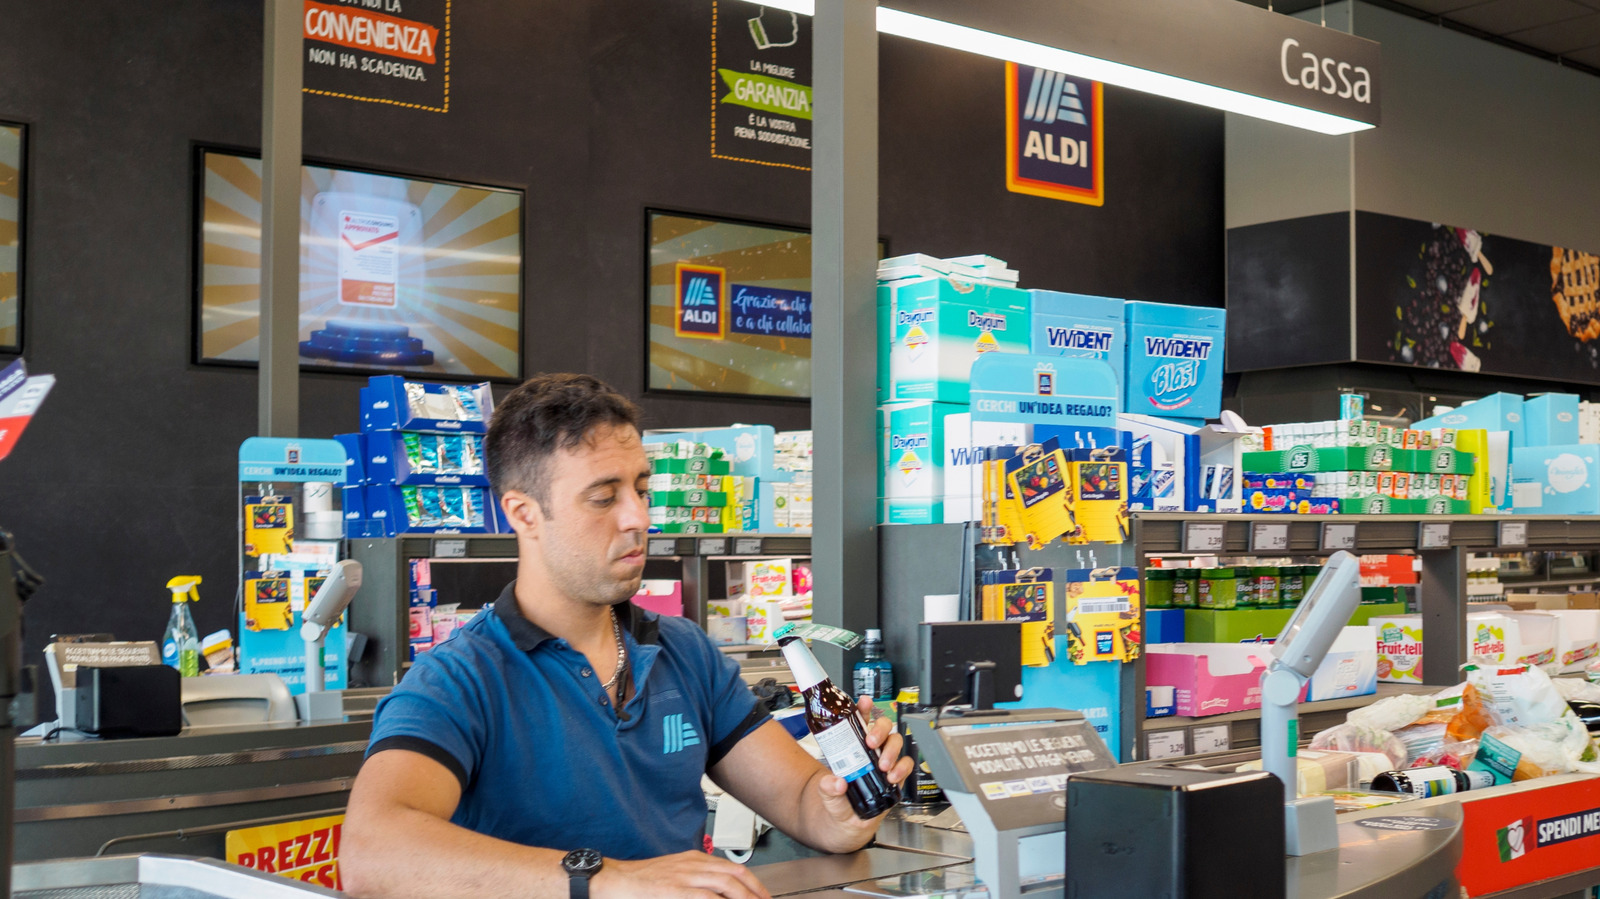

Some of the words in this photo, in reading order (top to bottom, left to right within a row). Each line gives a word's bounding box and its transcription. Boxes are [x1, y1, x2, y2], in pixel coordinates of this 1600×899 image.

[385, 0, 402, 13] LA
[305, 8, 433, 57] CONVENIENZA
[309, 48, 336, 66] NON
[340, 53, 358, 70] HA
[361, 57, 427, 82] SCADENZA.
[750, 60, 762, 72] LA
[763, 63, 796, 79] MIGLIORE
[1281, 38, 1371, 104] Cassa
[734, 78, 810, 112] GARANZIA
[734, 126, 757, 141] PIENA
[756, 116, 768, 128] LA
[769, 119, 797, 133] VOSTRA
[1023, 130, 1088, 168] ALDI
[733, 288, 778, 315] Grazie
[683, 309, 717, 324] ALDI
[977, 399, 1017, 413] CERCHI
[1019, 401, 1063, 415] UN'IDEA
[1066, 404, 1112, 417] REGALO?
[244, 467, 273, 475] CERCHI
[308, 468, 342, 476] REGALO?
[1208, 537, 1222, 546] 2,39
[1273, 537, 1287, 546] 2,19
[1082, 707, 1107, 719] ARTA
[964, 740, 1027, 759] ACCETTIAMO
[1025, 738, 1043, 753] LE
[1021, 755, 1038, 769] DI
[1539, 816, 1581, 843] SPENDI
[238, 824, 342, 875] PREZZI
